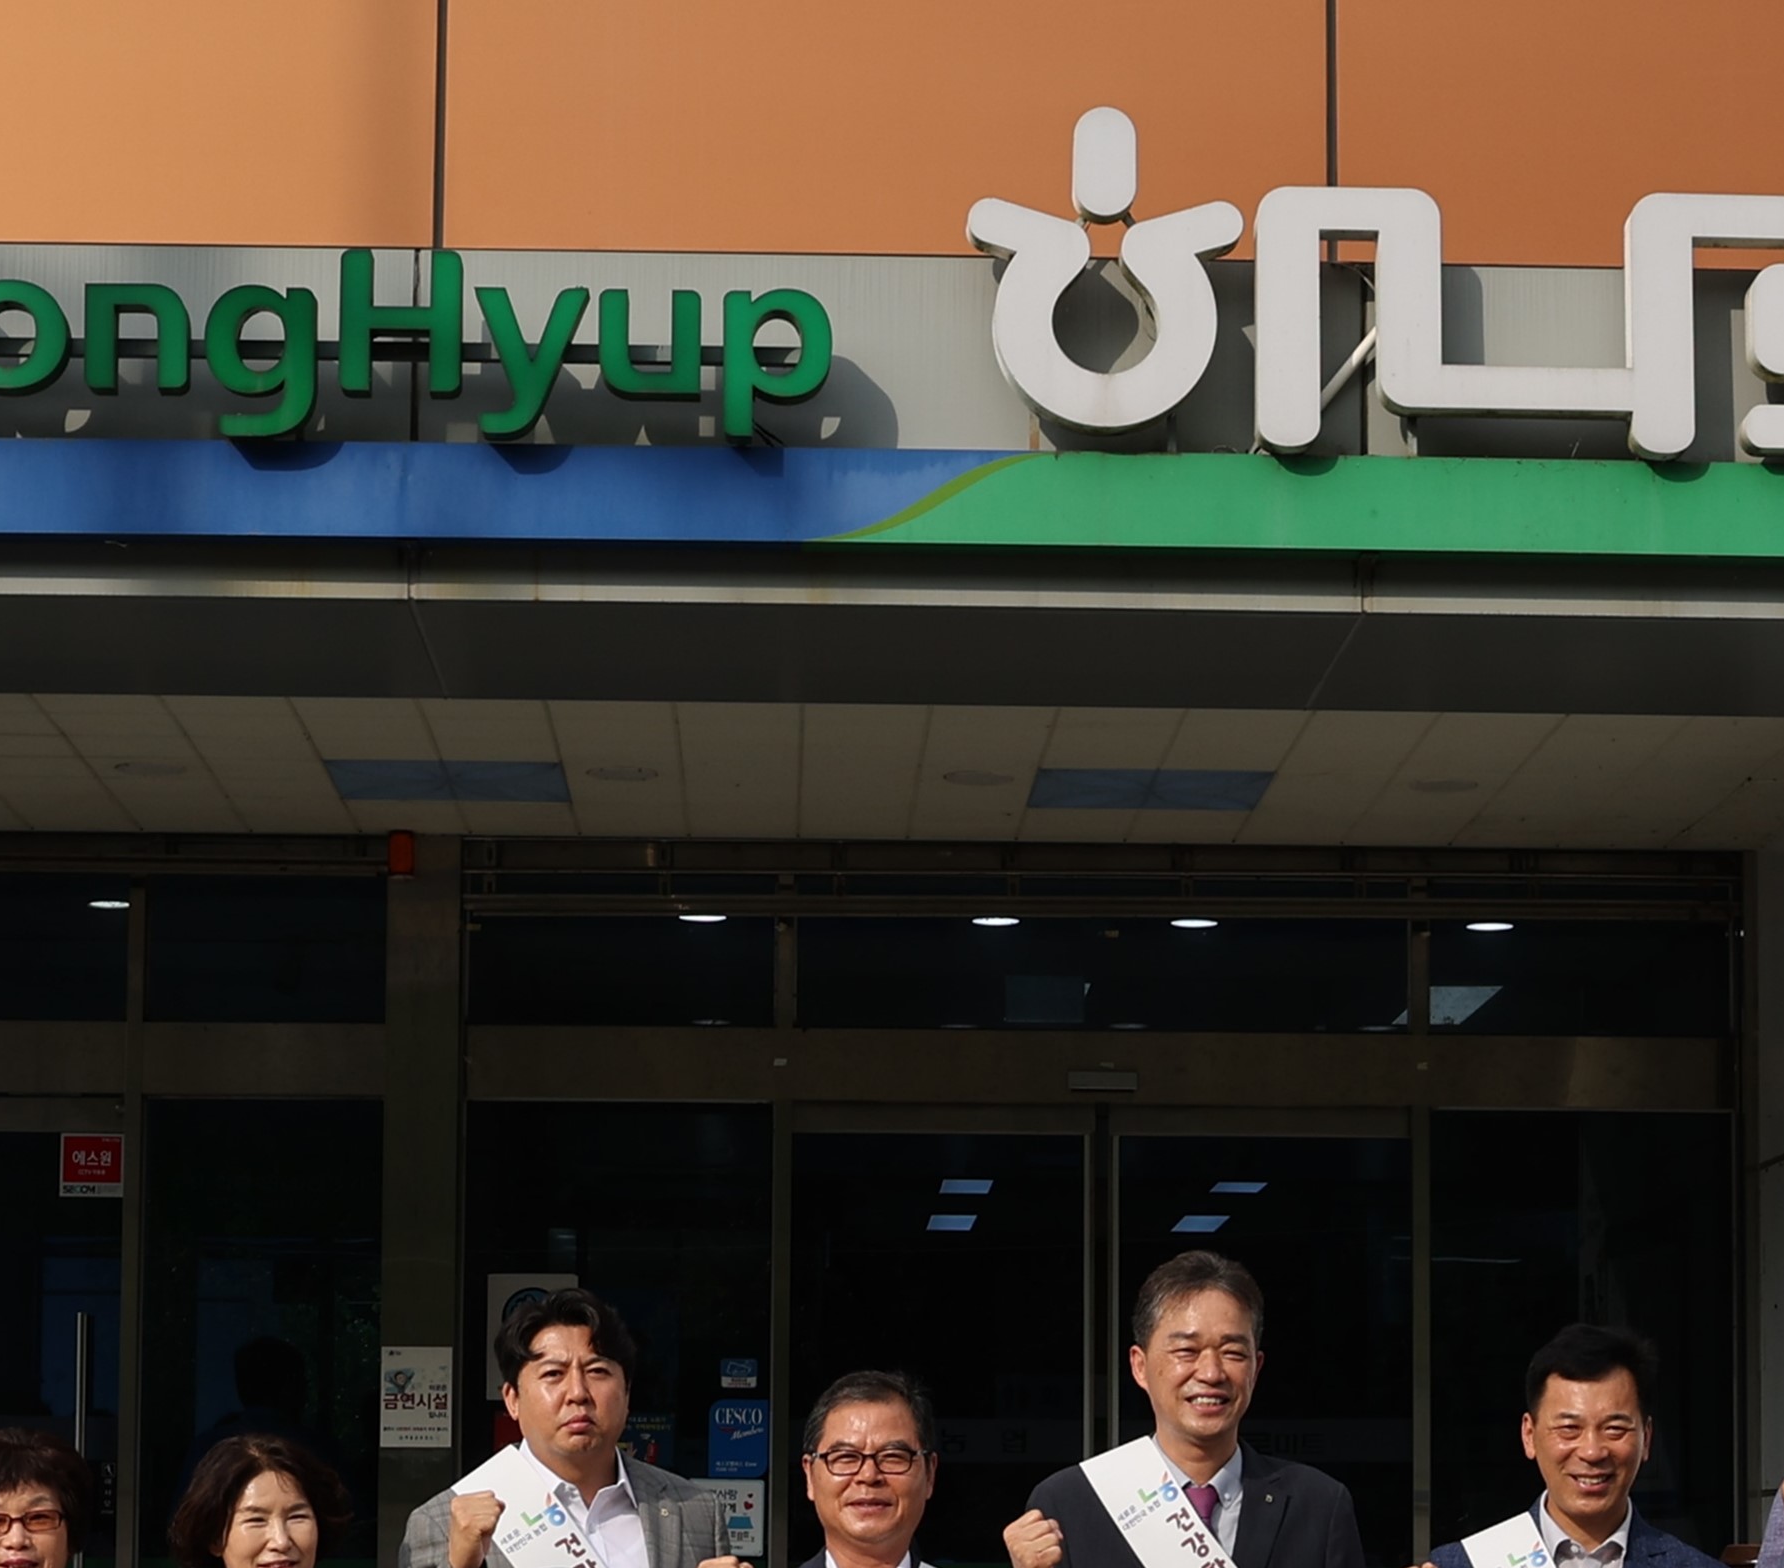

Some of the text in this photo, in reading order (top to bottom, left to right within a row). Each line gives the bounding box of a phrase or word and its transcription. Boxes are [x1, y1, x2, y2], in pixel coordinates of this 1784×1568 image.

[72, 1149, 113, 1167] 에스원
[383, 1392, 448, 1410] 금연시설
[715, 1407, 763, 1426] CESCO
